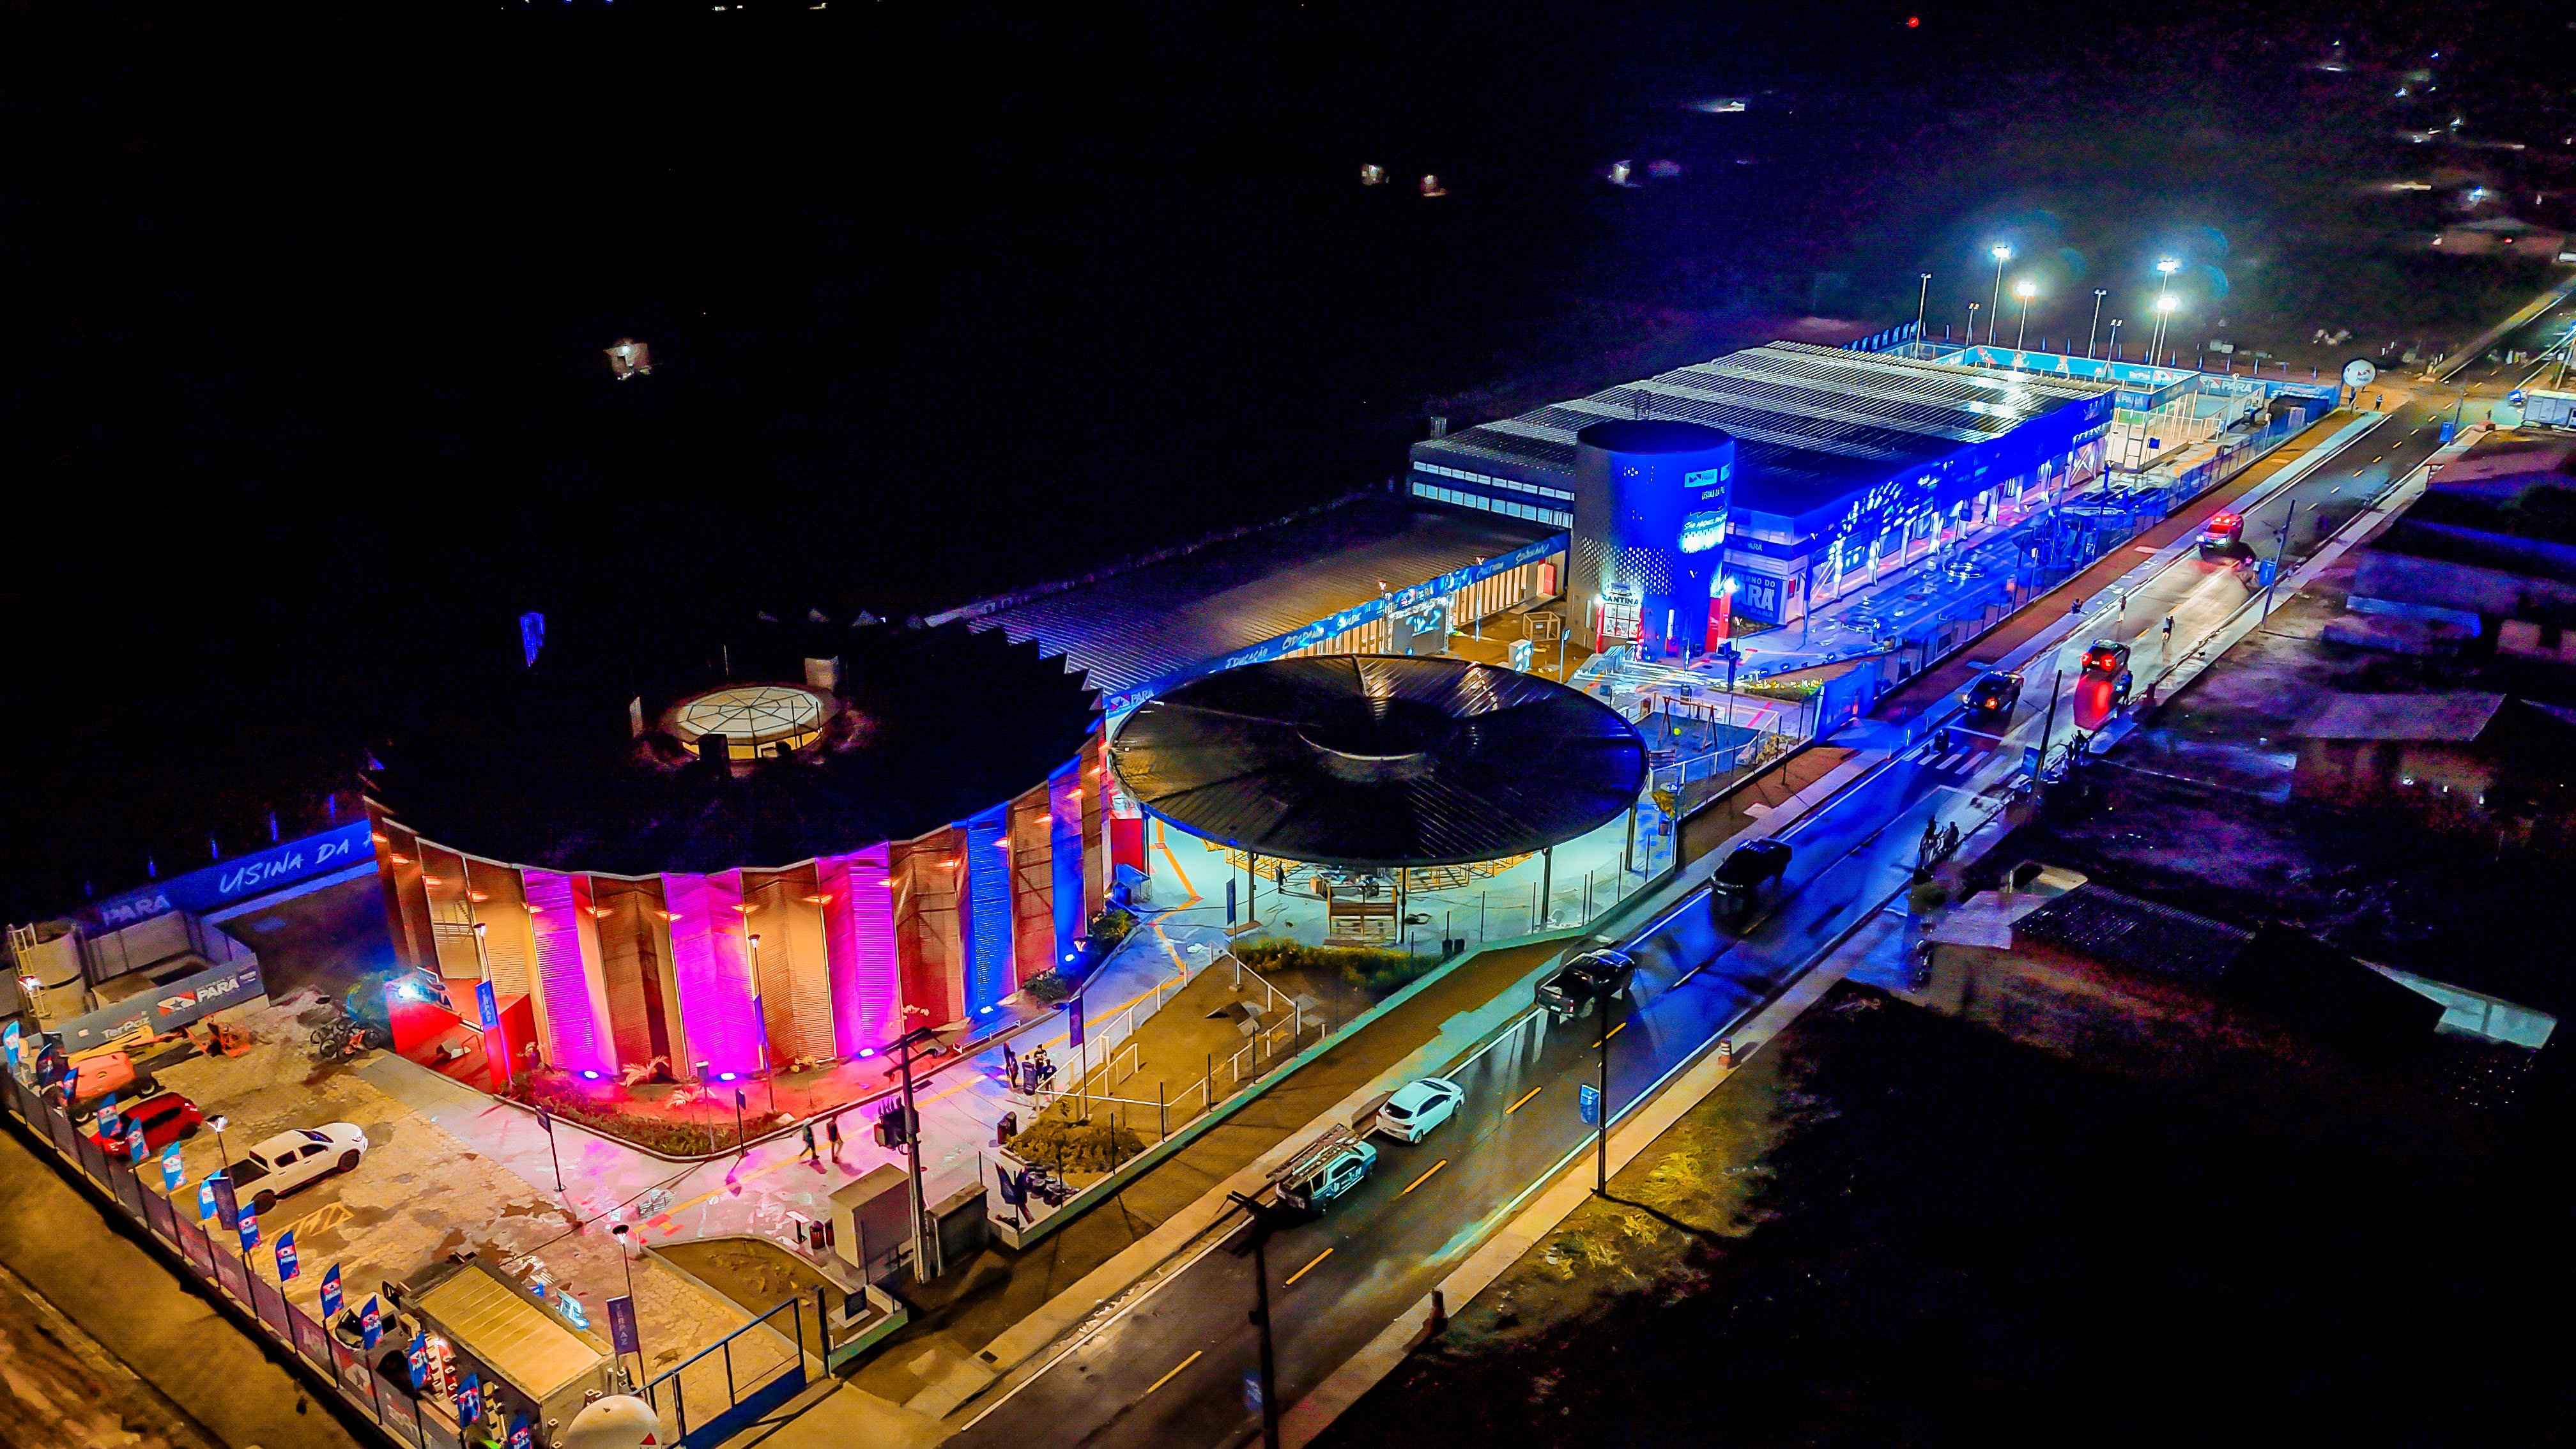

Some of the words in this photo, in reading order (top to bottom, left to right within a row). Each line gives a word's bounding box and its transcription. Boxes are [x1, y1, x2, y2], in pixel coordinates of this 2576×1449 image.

[1765, 579, 1775, 588] DO
[218, 851, 304, 894] USINA
[314, 838, 351, 864] DA
[615, 1303, 629, 1346] TERPAZ
